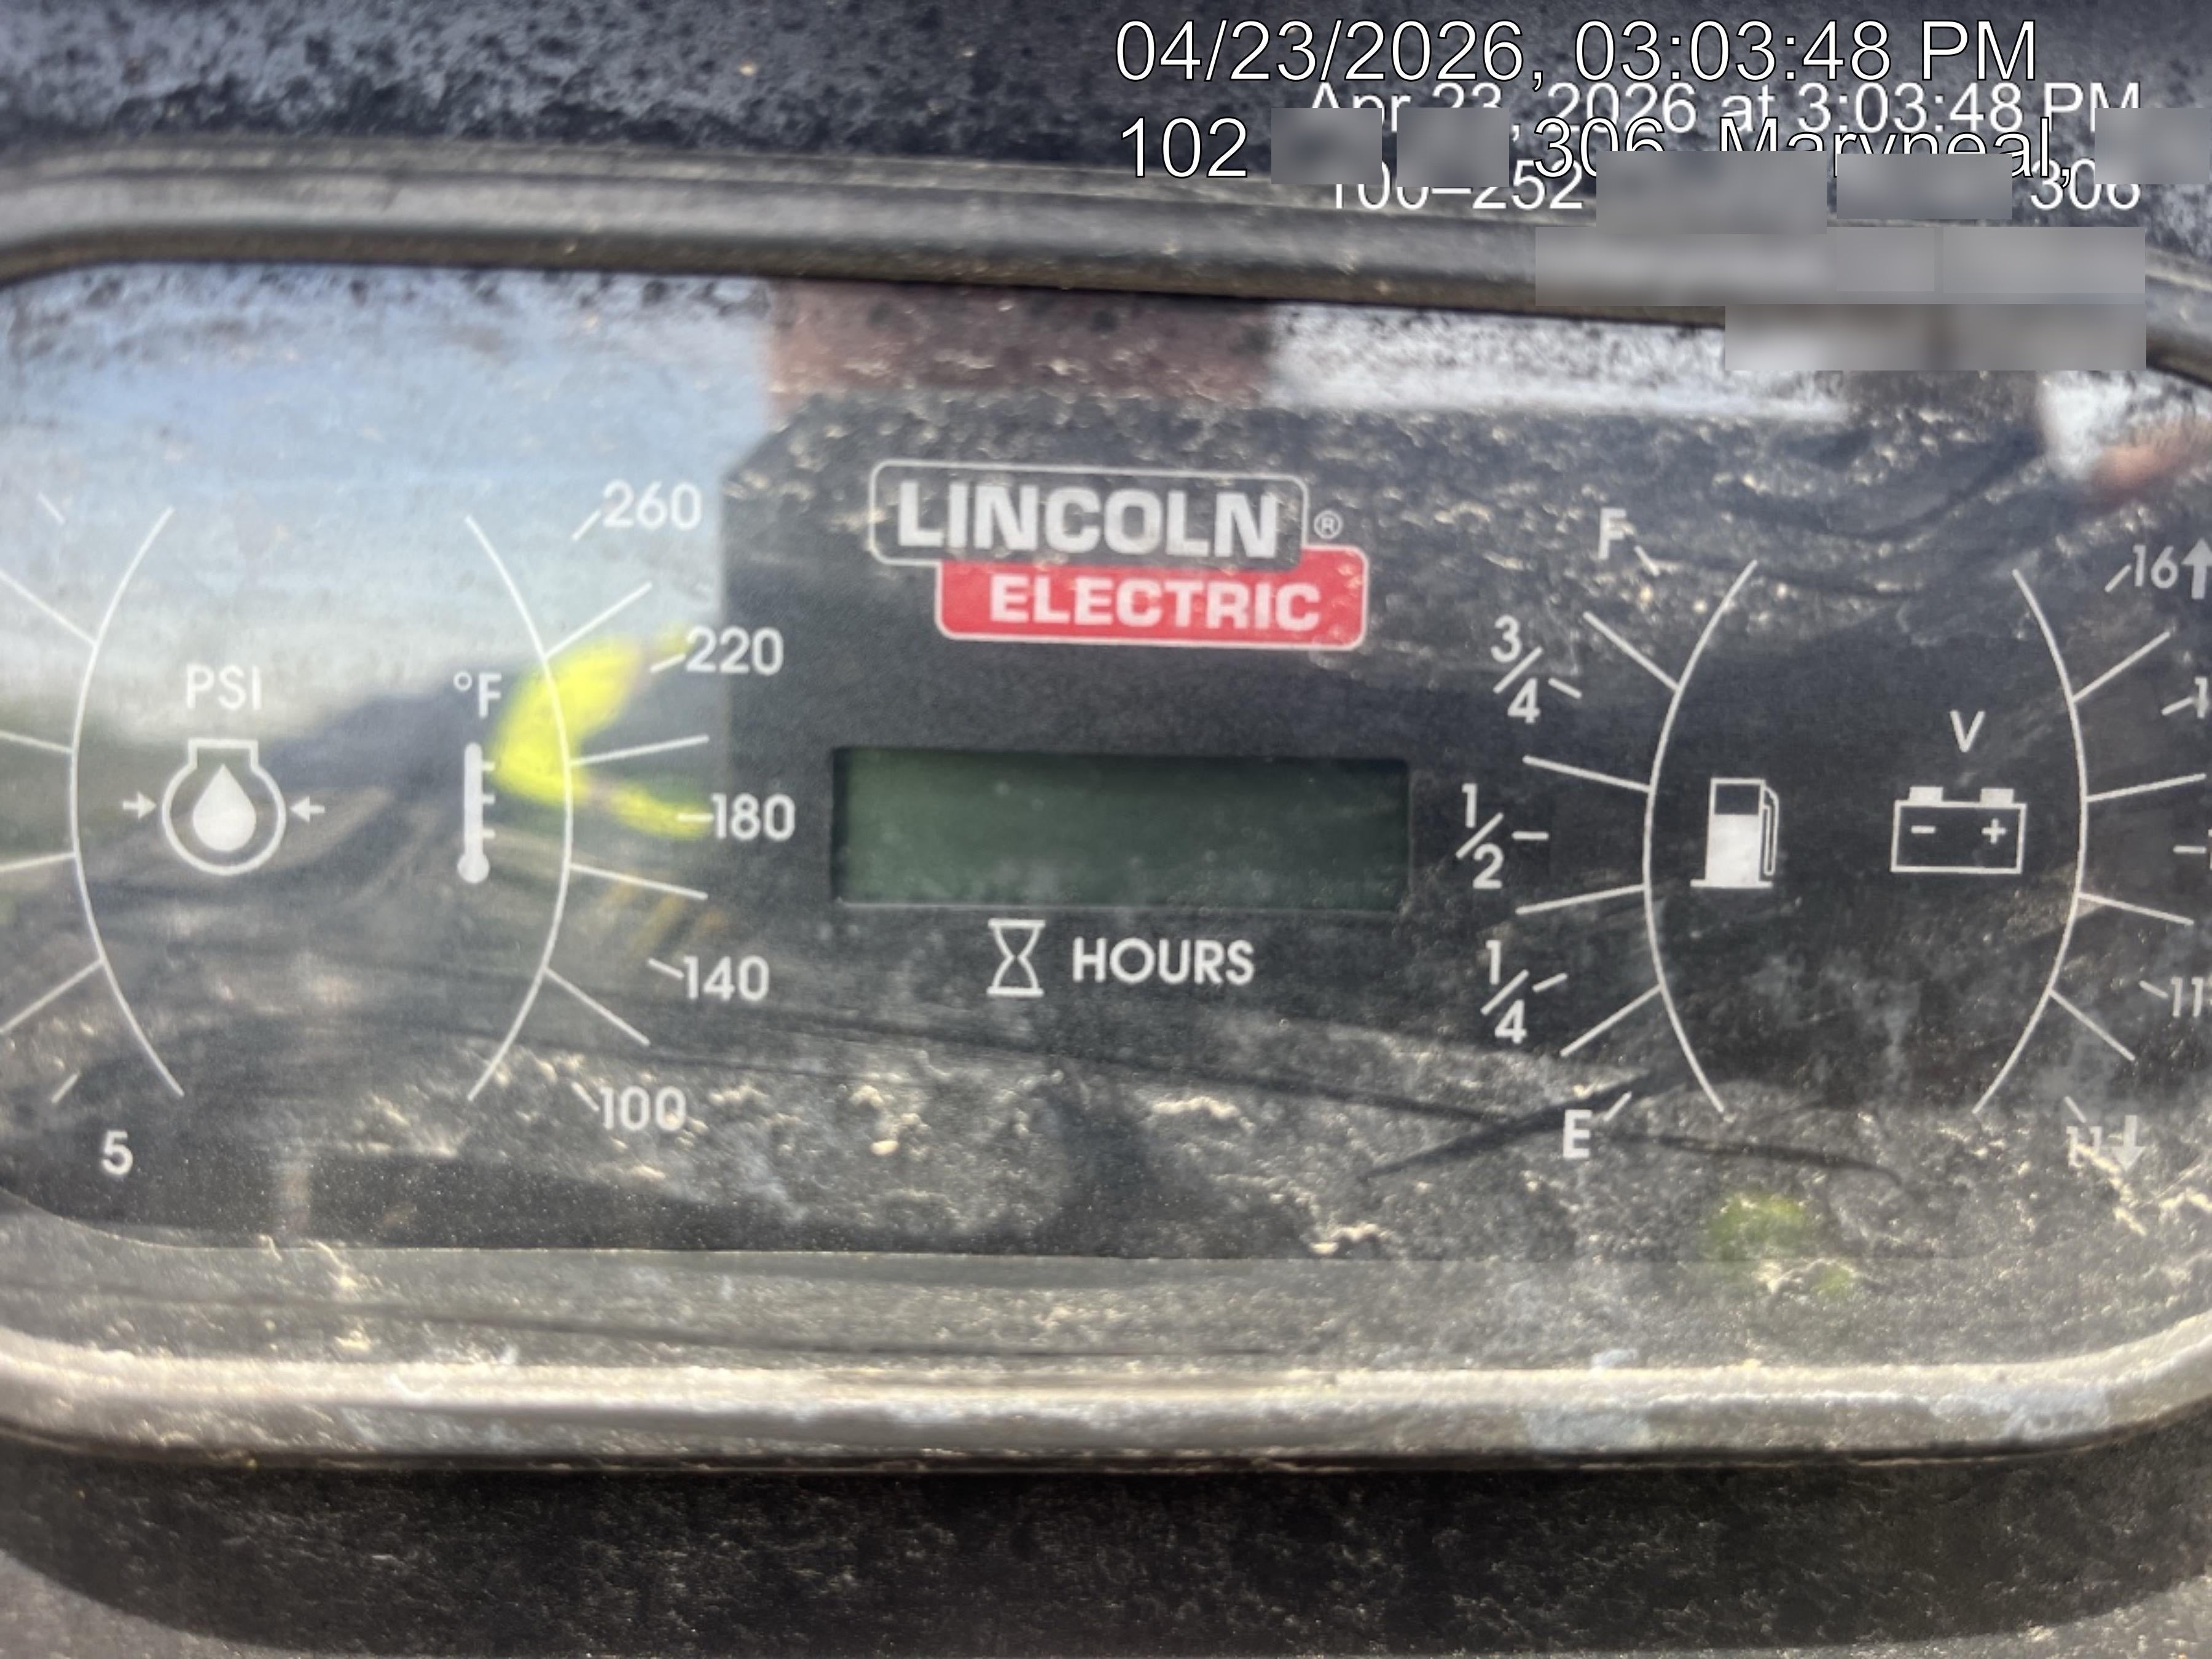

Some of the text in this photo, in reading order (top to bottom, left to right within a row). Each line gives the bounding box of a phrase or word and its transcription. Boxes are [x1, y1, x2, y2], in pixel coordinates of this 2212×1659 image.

[602, 479, 702, 530] 260
[897, 480, 1279, 559] LINCOLN
[1598, 507, 1627, 560] F
[2132, 544, 2179, 589] 16
[989, 572, 1322, 632] ELECTRIC
[686, 626, 785, 675] 220
[1491, 614, 1543, 724] 3/4
[185, 663, 263, 711] PSI
[1950, 710, 1986, 753] V
[711, 792, 796, 841] 180
[1455, 782, 1505, 890] 1/2
[682, 955, 770, 1002] 140
[1072, 936, 1255, 986] HOURS
[1480, 939, 1529, 1043] 1/4
[598, 1086, 687, 1132] 100
[1562, 1109, 1593, 1159] E
[100, 1129, 134, 1176] 5
